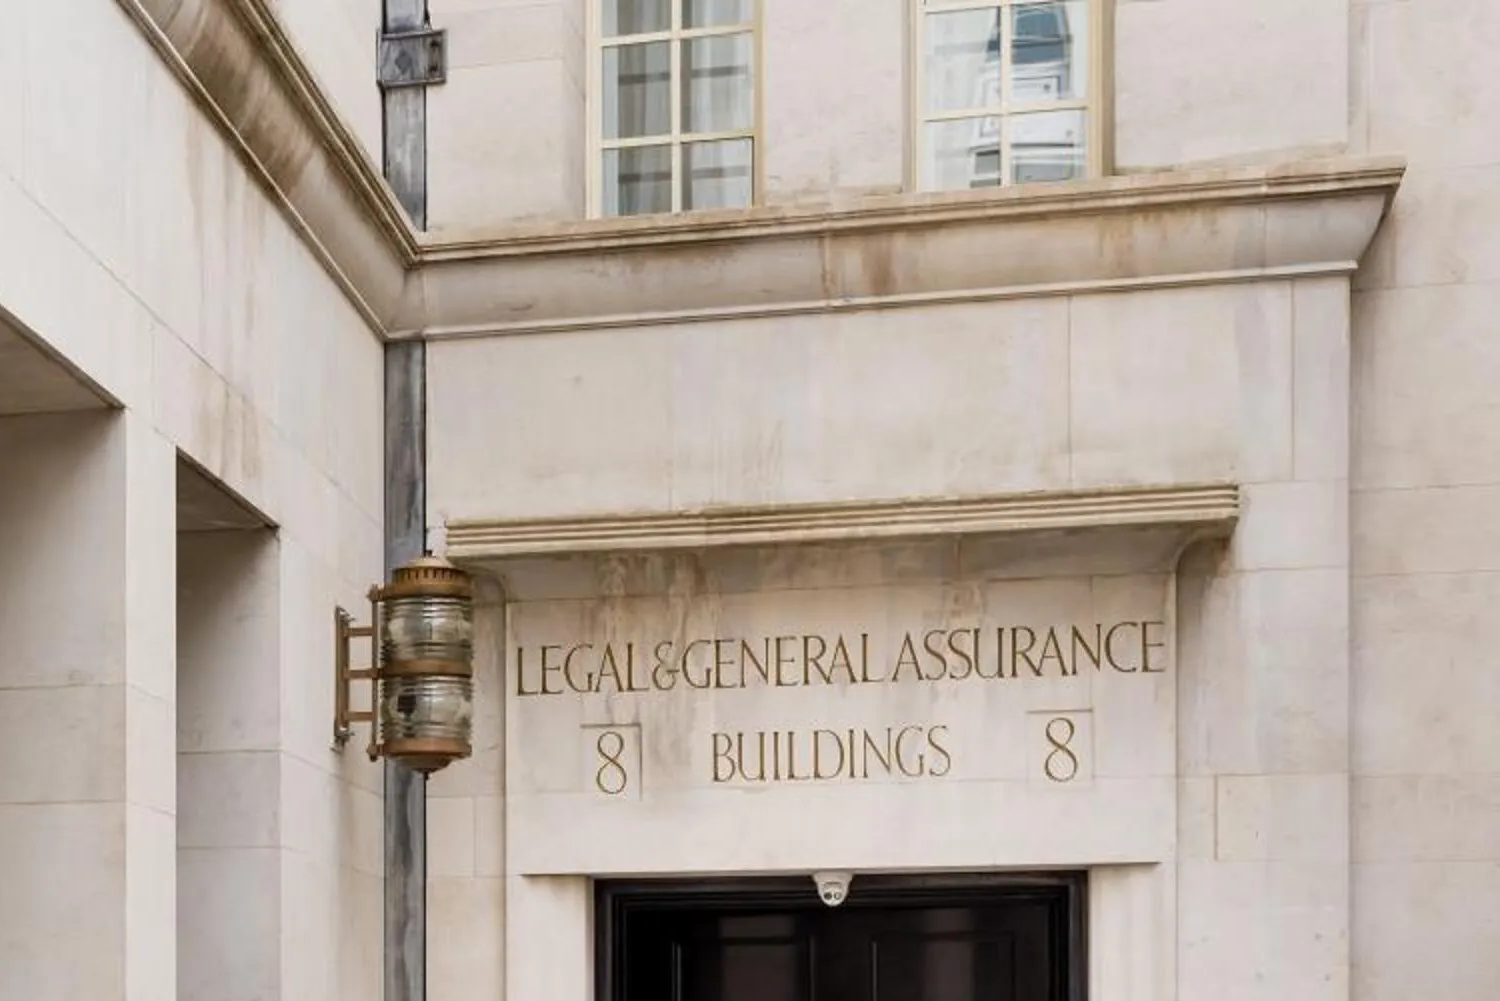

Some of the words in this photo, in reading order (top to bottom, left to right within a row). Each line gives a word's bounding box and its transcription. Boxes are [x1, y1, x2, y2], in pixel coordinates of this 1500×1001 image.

[891, 620, 1166, 683] ASSURANCE
[595, 731, 628, 795] 8
[711, 725, 951, 783] BUILDINGS
[1044, 717, 1078, 783] 8
